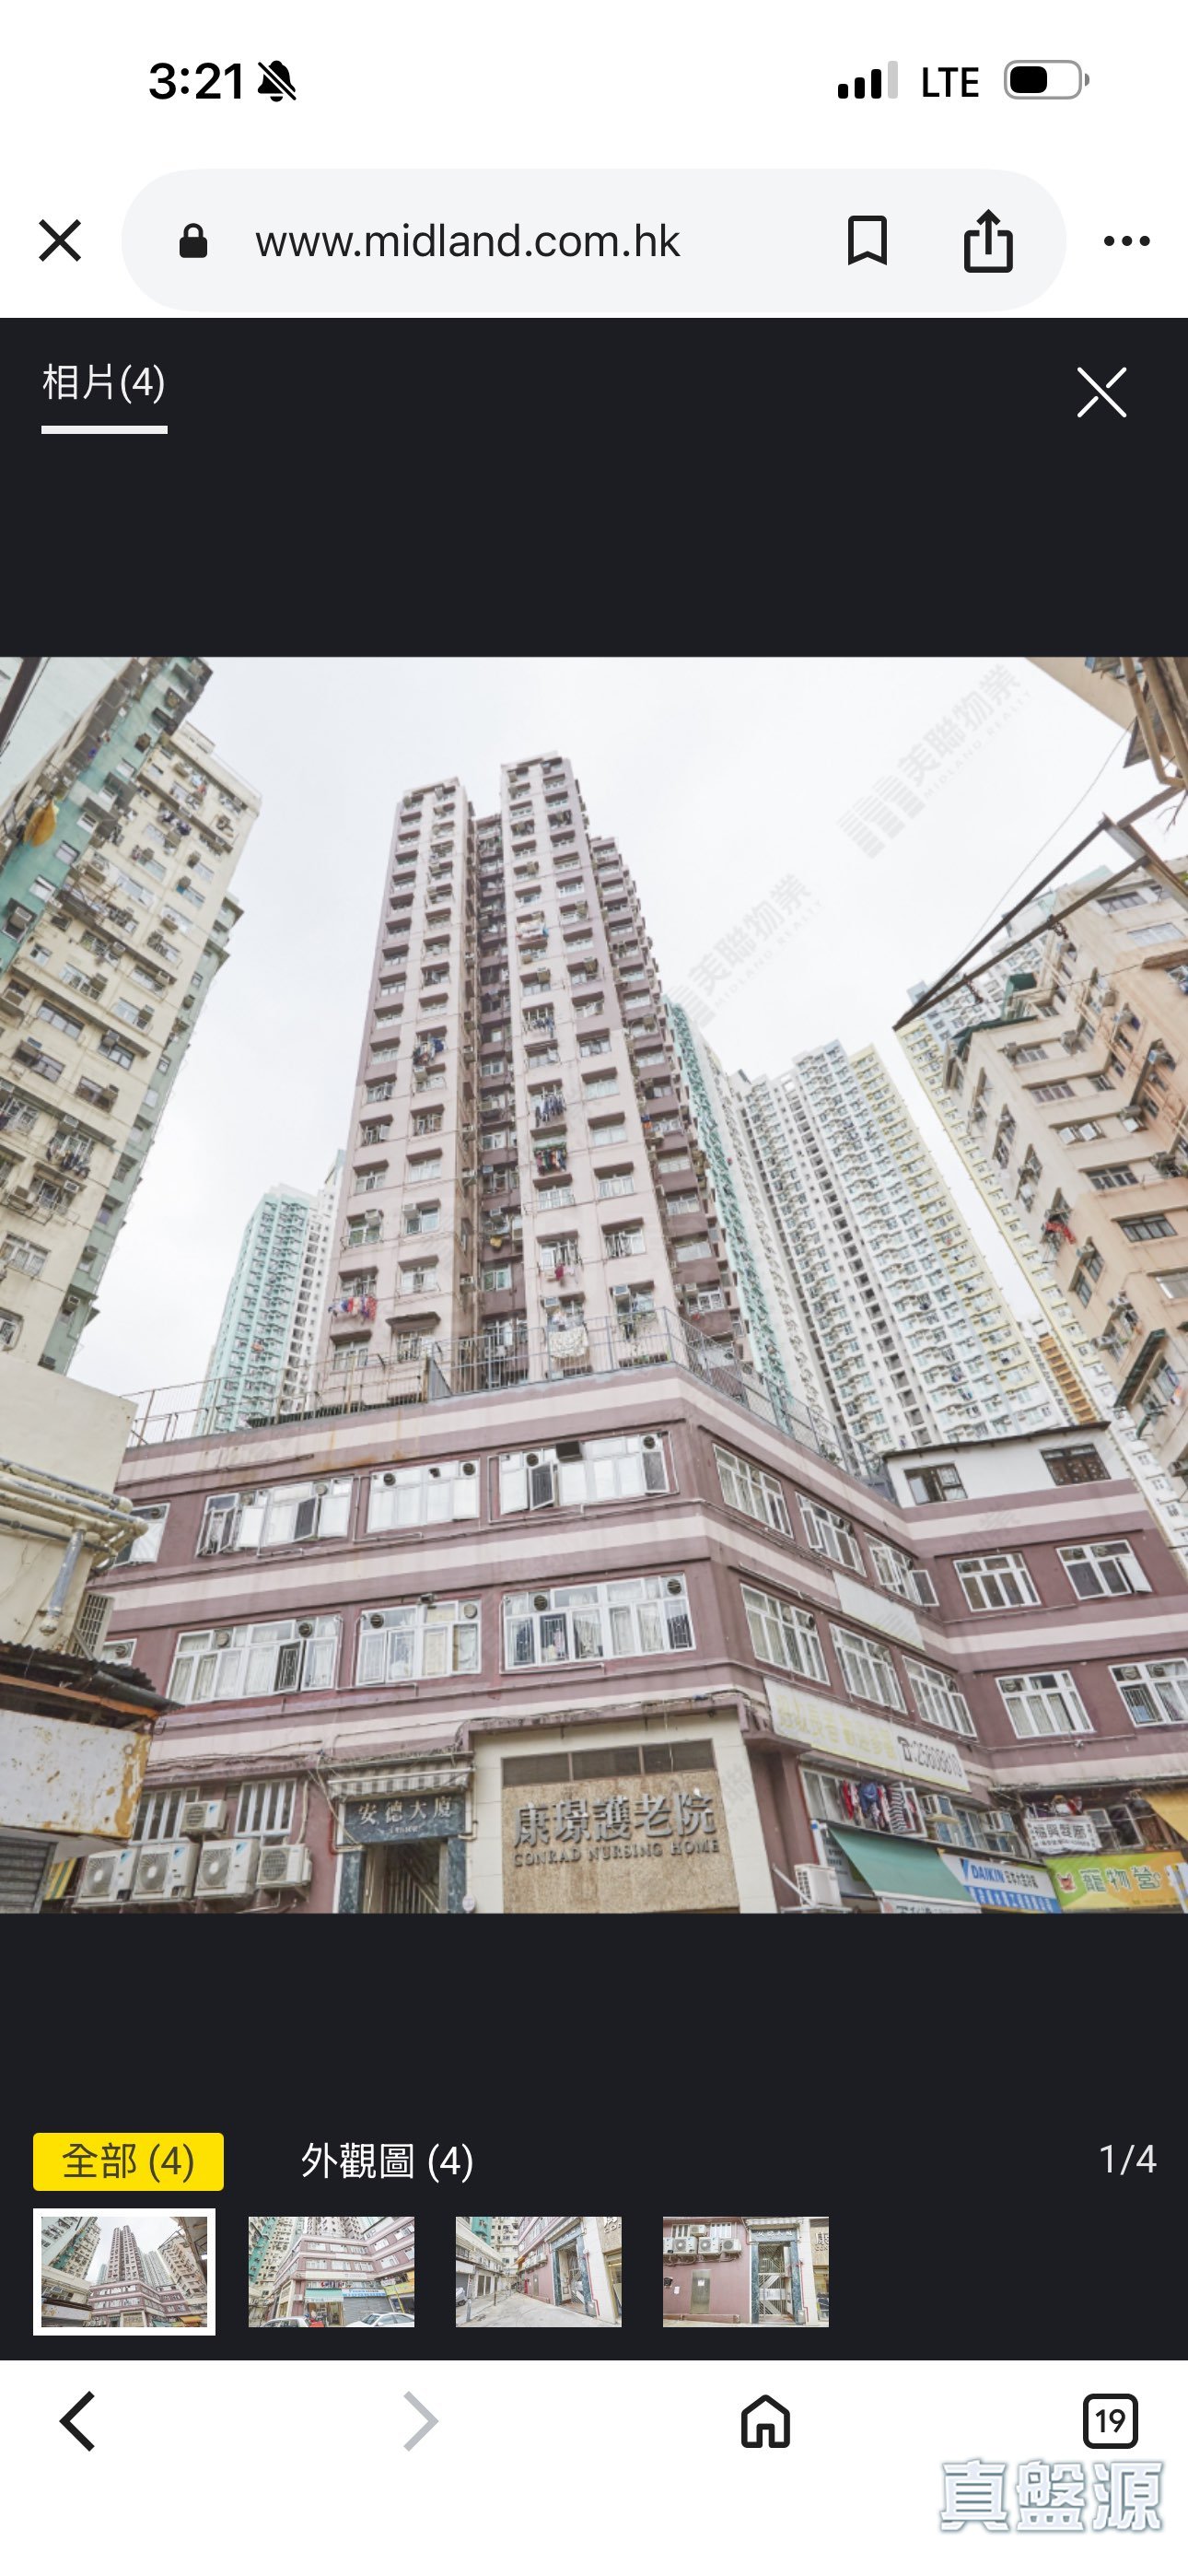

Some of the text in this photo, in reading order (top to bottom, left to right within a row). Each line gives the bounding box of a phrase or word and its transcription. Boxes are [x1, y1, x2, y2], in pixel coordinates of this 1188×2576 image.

[148, 62, 241, 100] 3:21
[922, 66, 980, 98] LTE
[255, 222, 681, 258] www.midland.com.hk
[42, 362, 165, 405] 相片(4)
[358, 1796, 453, 1825] 安德大廈
[513, 1786, 717, 1850] 康璟護老院
[514, 1839, 721, 1868] CONRAD NURSING HOME
[970, 1864, 1006, 1884] DAIKIN
[62, 2141, 194, 2184] 全部 (4)
[301, 2142, 473, 2184] 外觀圖 (4)
[1100, 2144, 1158, 2176] 1/4
[1095, 2408, 1126, 2433] 19
